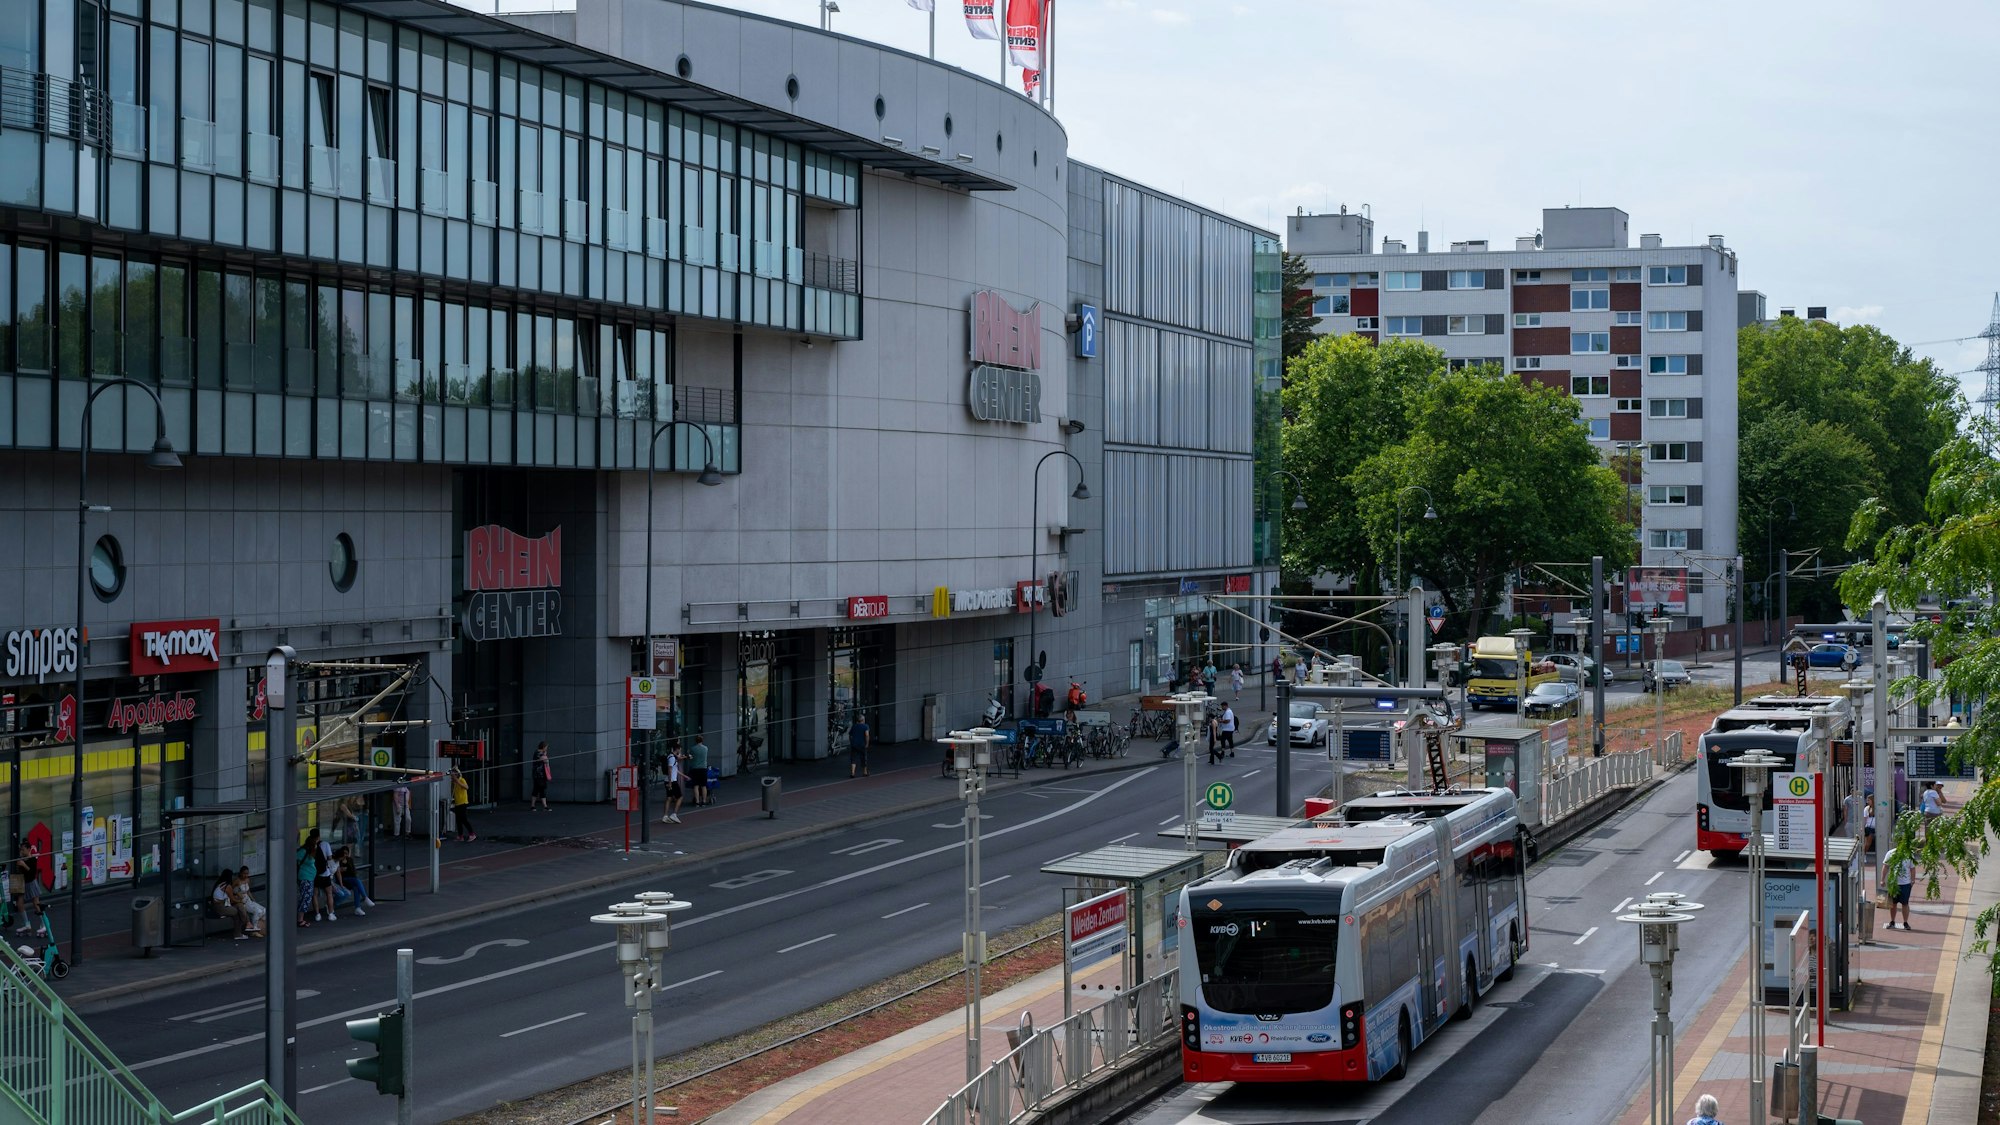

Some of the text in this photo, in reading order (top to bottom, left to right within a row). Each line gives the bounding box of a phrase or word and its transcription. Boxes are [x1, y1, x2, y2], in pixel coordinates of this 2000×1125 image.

[973, 290, 1041, 370] RHEIN
[1086, 323, 1093, 351] P
[973, 365, 1042, 424] CENTER
[468, 523, 561, 591] RHEIN
[467, 590, 562, 642] CENTER
[7, 628, 78, 685] snipes
[107, 691, 197, 734] Apotheke
[1764, 882, 1800, 894] Google
[1764, 892, 1786, 902] Pixel
[1073, 903, 1125, 937] Weiden Zentrum
[1210, 925, 1227, 934] KVB
[1203, 1023, 1237, 1031] Ökostrom
